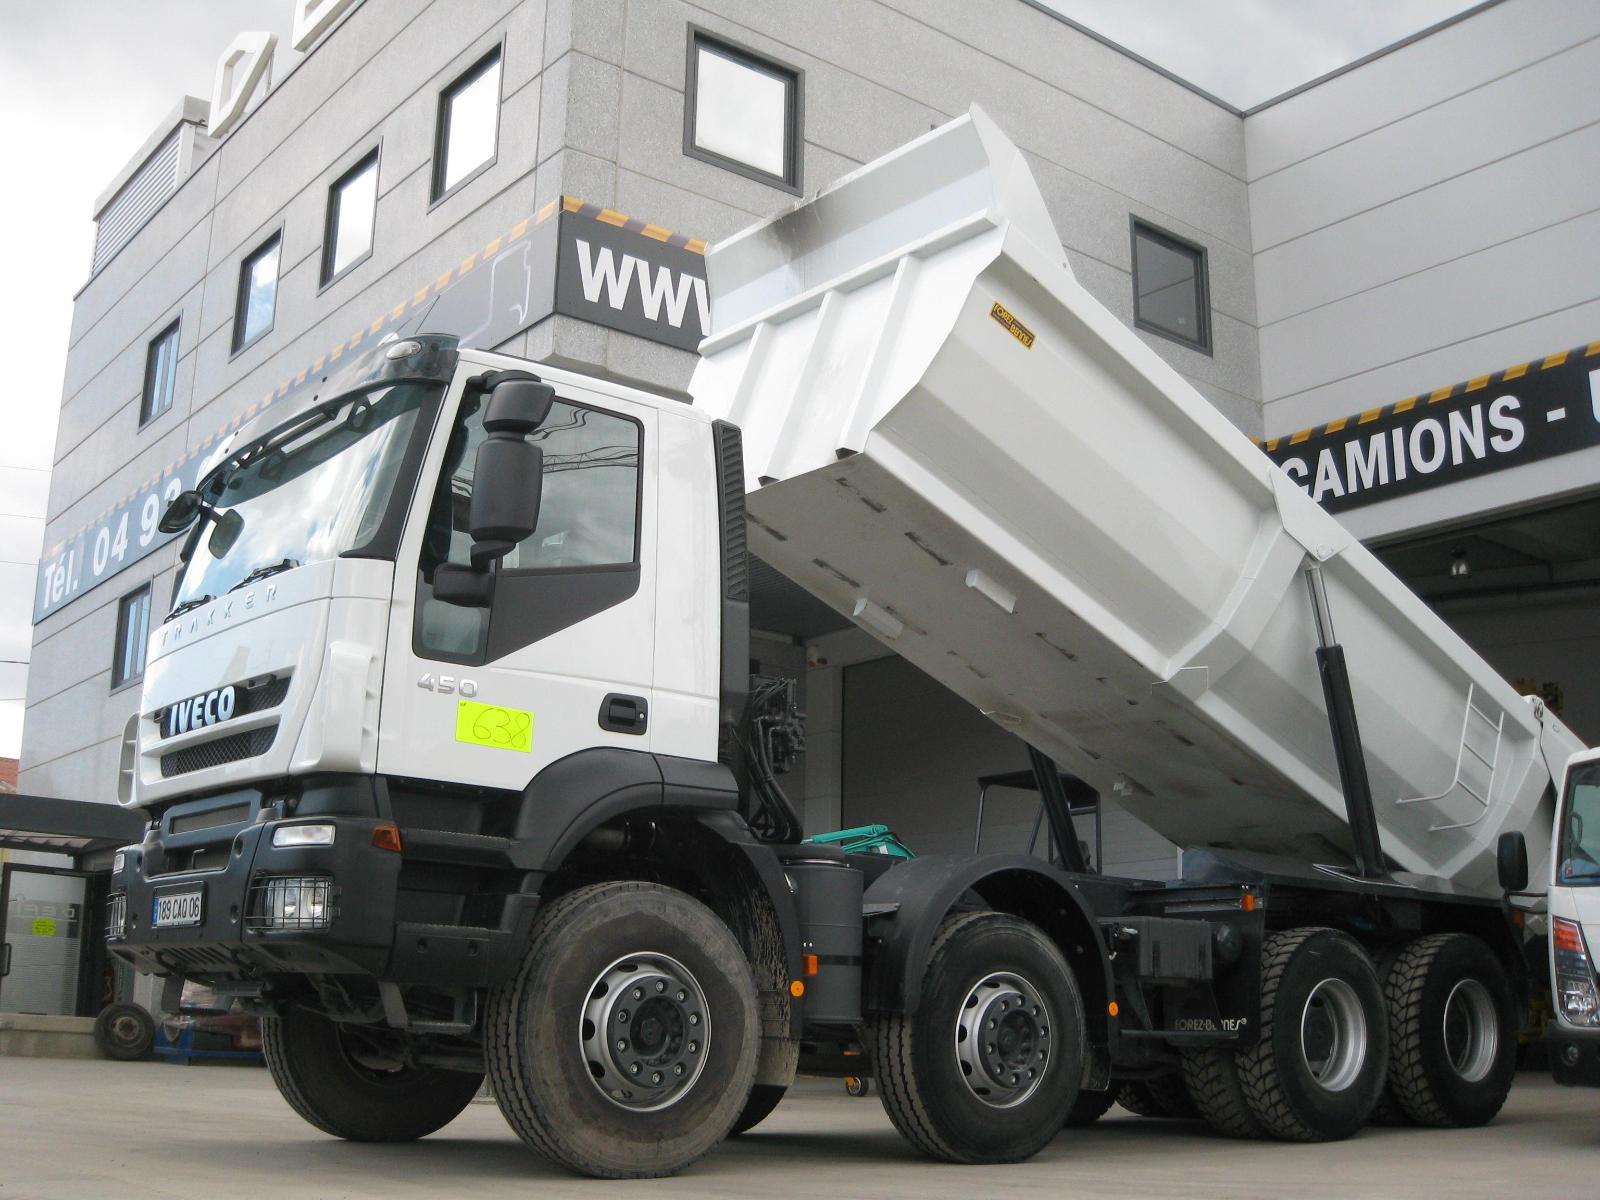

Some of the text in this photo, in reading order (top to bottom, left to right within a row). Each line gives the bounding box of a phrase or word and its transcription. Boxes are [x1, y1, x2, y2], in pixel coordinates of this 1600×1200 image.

[44, 550, 79, 609] Tél.
[93, 512, 130, 577] 04
[160, 584, 277, 647] TRAKKER
[417, 672, 478, 698] 450
[169, 685, 236, 737] IVECO
[472, 707, 531, 749] 638
[159, 899, 171, 920] 189
[189, 897, 200, 918] 06
